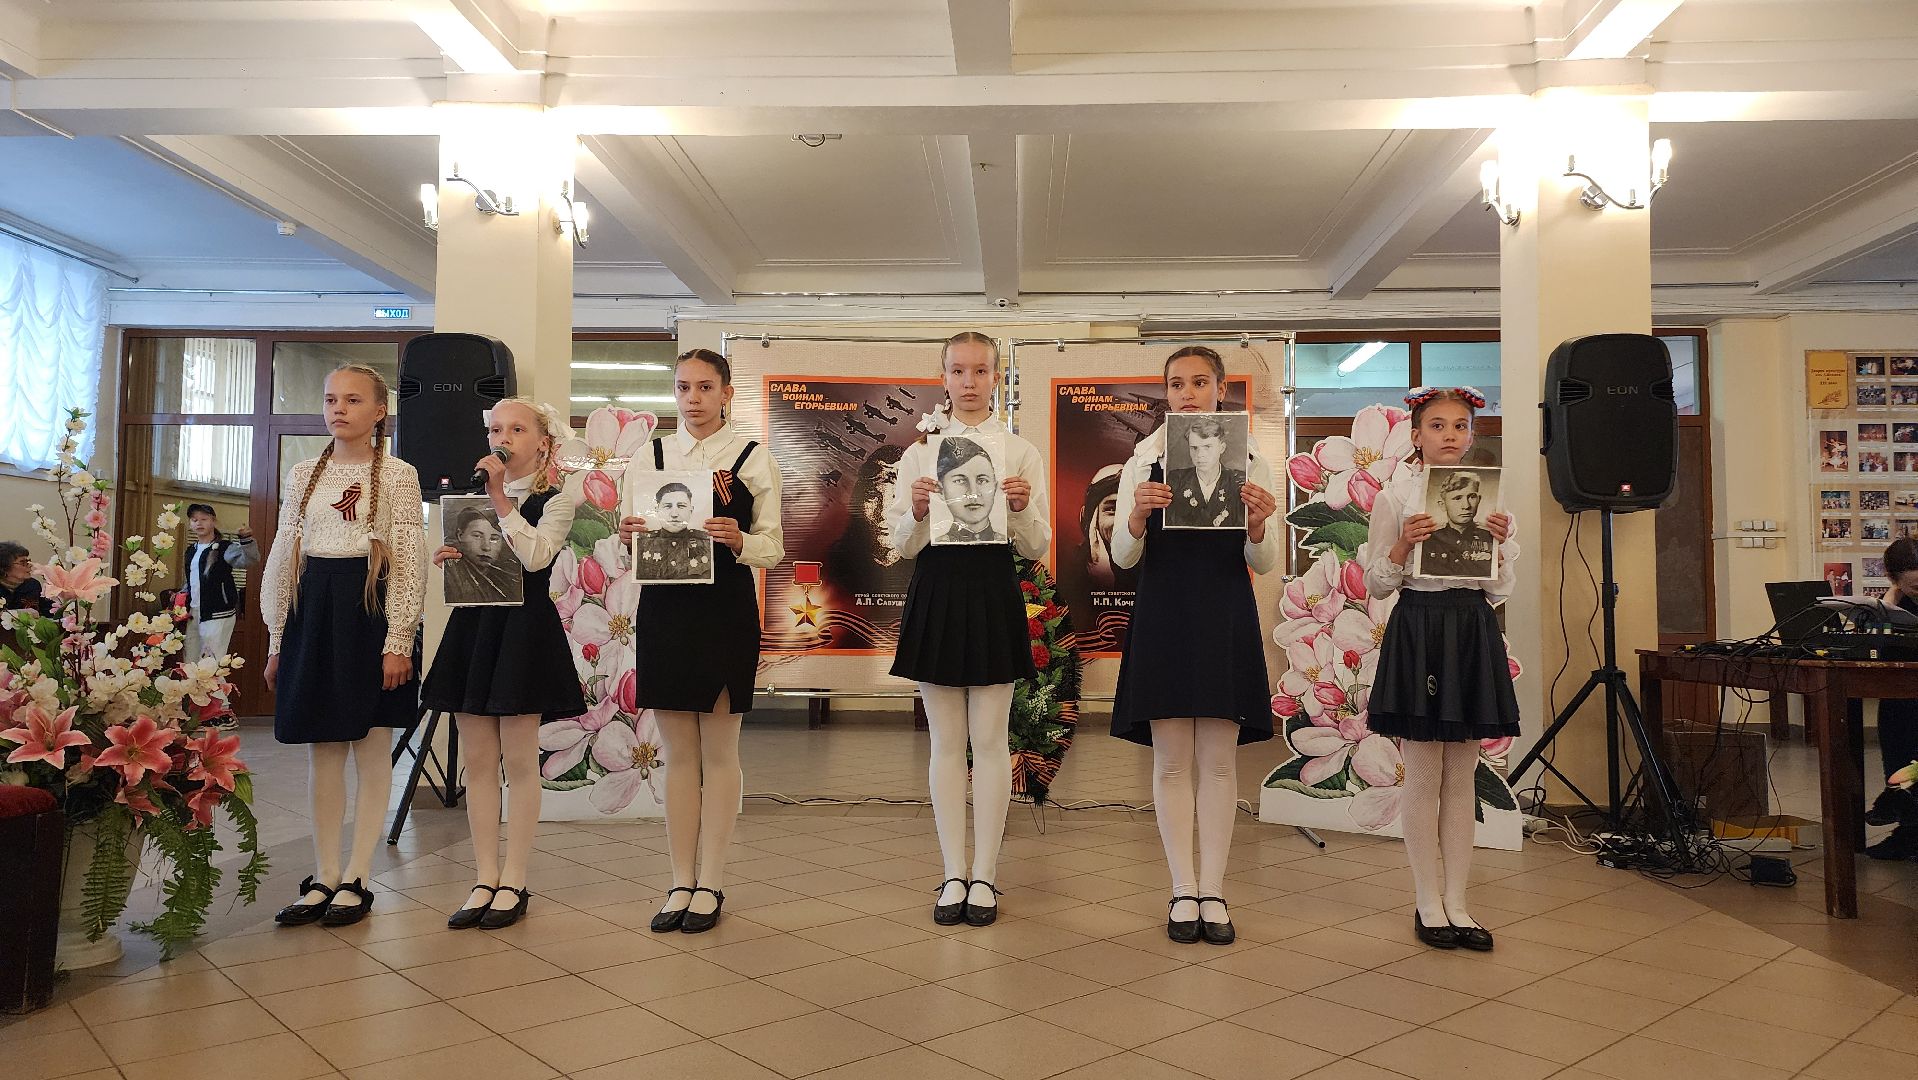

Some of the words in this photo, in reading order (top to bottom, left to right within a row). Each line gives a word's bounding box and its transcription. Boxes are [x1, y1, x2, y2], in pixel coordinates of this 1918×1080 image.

[433, 383, 463, 392] EON
[770, 383, 807, 393] СЛАВА
[1059, 386, 1096, 395] СЛАВА
[1607, 385, 1639, 395] EON
[794, 402, 858, 411] ЕГОРЬЕВЦАМ
[1083, 403, 1148, 412] ЕГОРЬЕВЦАМ
